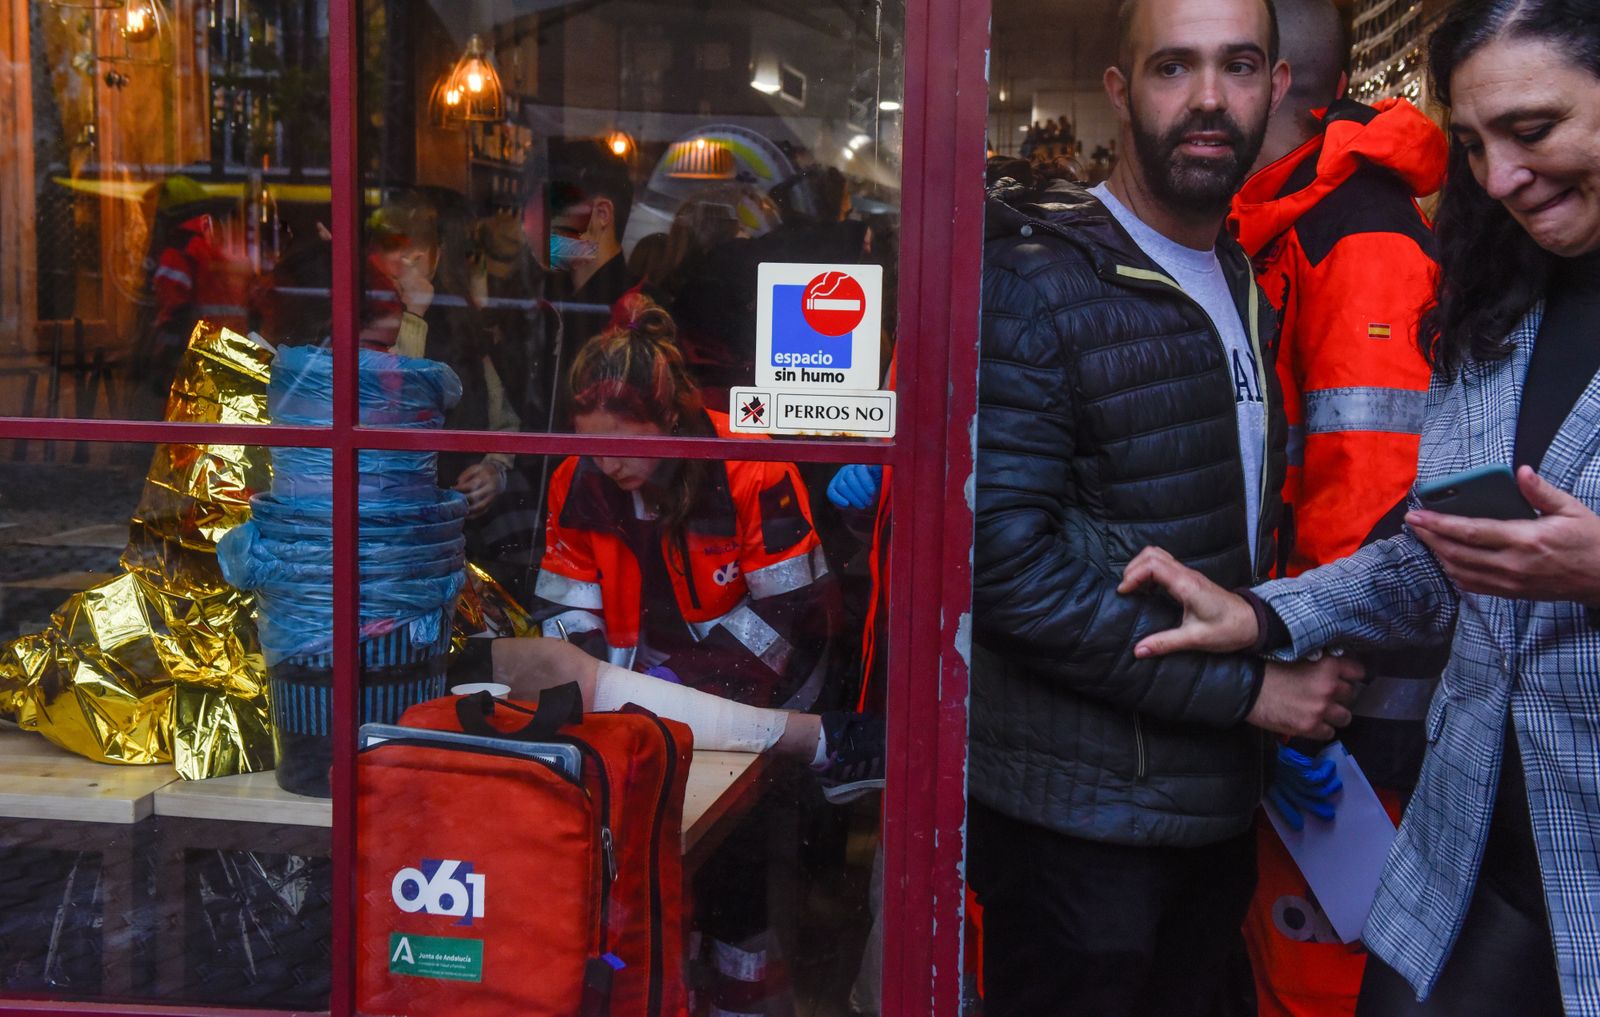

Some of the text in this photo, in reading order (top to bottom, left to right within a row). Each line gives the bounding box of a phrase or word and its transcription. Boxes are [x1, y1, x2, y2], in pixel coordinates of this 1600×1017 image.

[774, 350, 833, 367] espacio
[774, 368, 845, 383] sin humo
[784, 404, 884, 421] PERROS NO
[391, 859, 486, 918] 061
[418, 952, 435, 960] Junta
